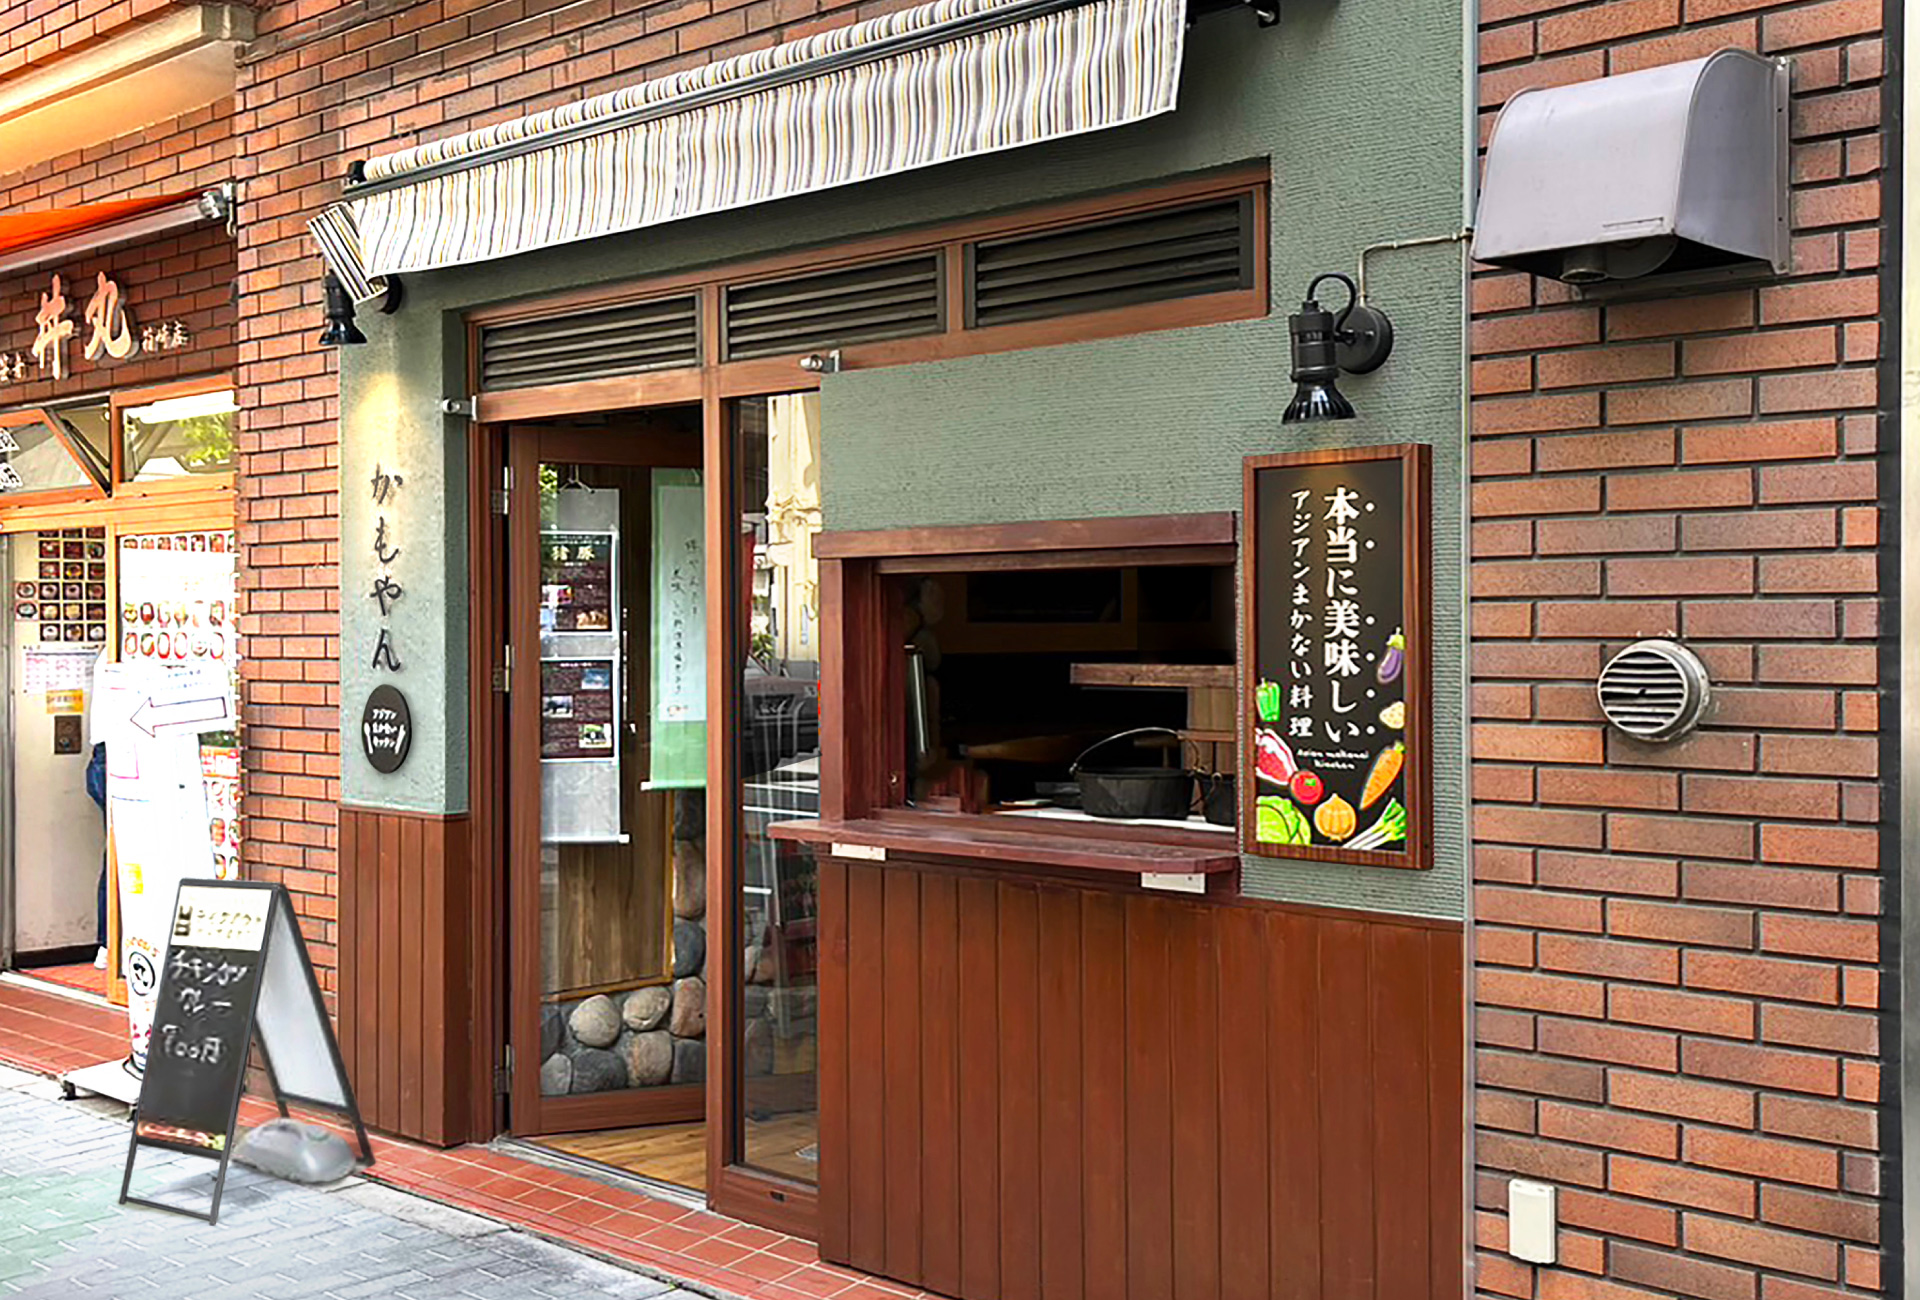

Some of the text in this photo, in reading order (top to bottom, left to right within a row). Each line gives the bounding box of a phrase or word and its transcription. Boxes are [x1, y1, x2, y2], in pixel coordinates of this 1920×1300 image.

[369, 463, 403, 673] かもやん
[1289, 489, 1314, 737] アジアンまかない料理
[1323, 487, 1361, 743] 本当に美味しい
